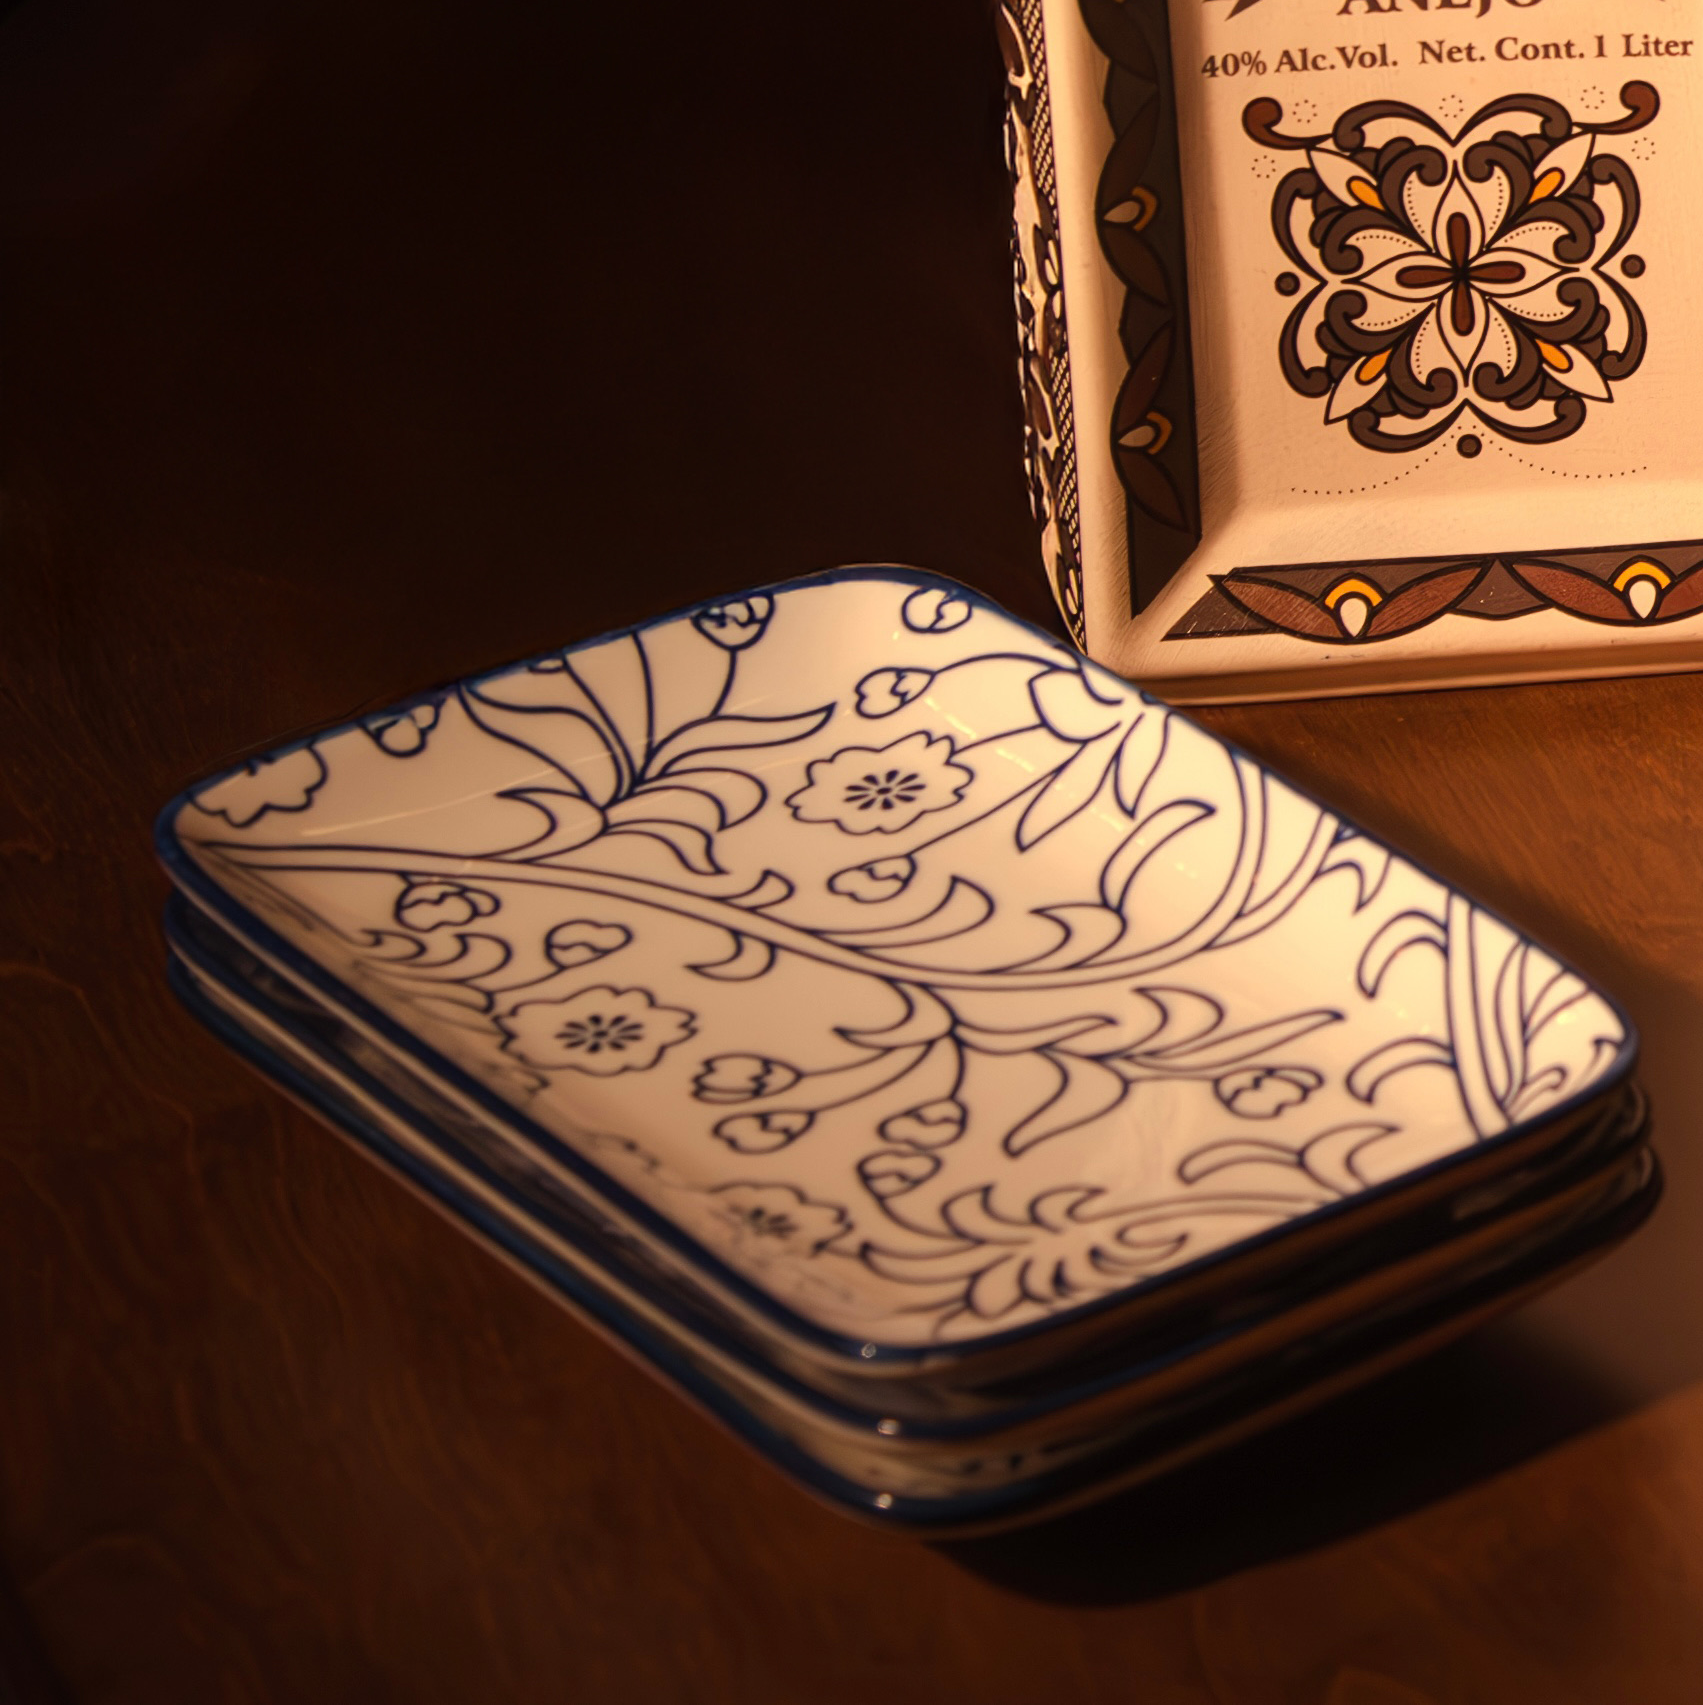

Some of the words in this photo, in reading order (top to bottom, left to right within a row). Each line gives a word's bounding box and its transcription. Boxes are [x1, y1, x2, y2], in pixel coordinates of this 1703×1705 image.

[1202, 51, 1267, 78] 40%
[1419, 40, 1485, 64] Net.
[1495, 37, 1584, 61] Cont.
[1595, 35, 1606, 57] 1
[1622, 34, 1693, 57] Liter
